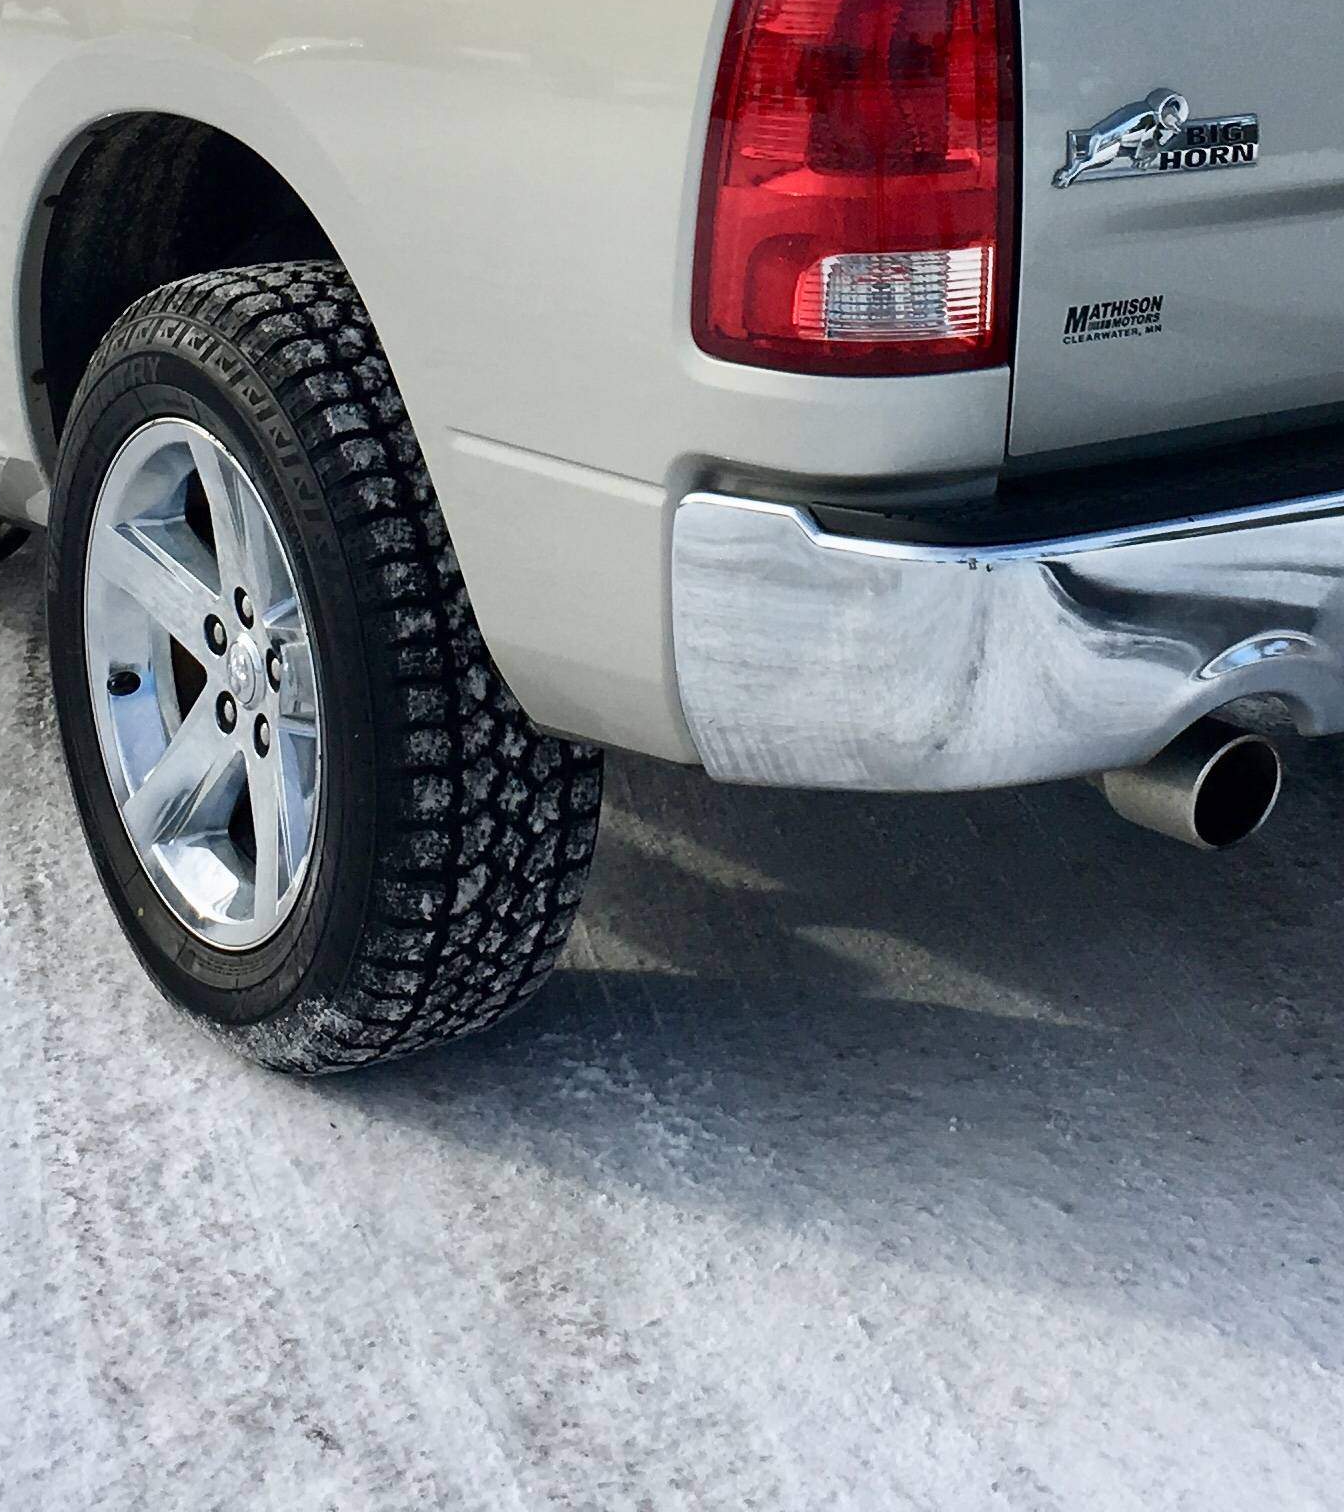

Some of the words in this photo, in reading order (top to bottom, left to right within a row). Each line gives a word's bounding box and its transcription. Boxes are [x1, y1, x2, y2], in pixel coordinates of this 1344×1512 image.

[1186, 121, 1243, 146] BIG
[1159, 143, 1255, 170] HORN
[1064, 295, 1164, 335] MATHISON
[1112, 313, 1161, 329] MOTORS
[1144, 324, 1163, 334] MN
